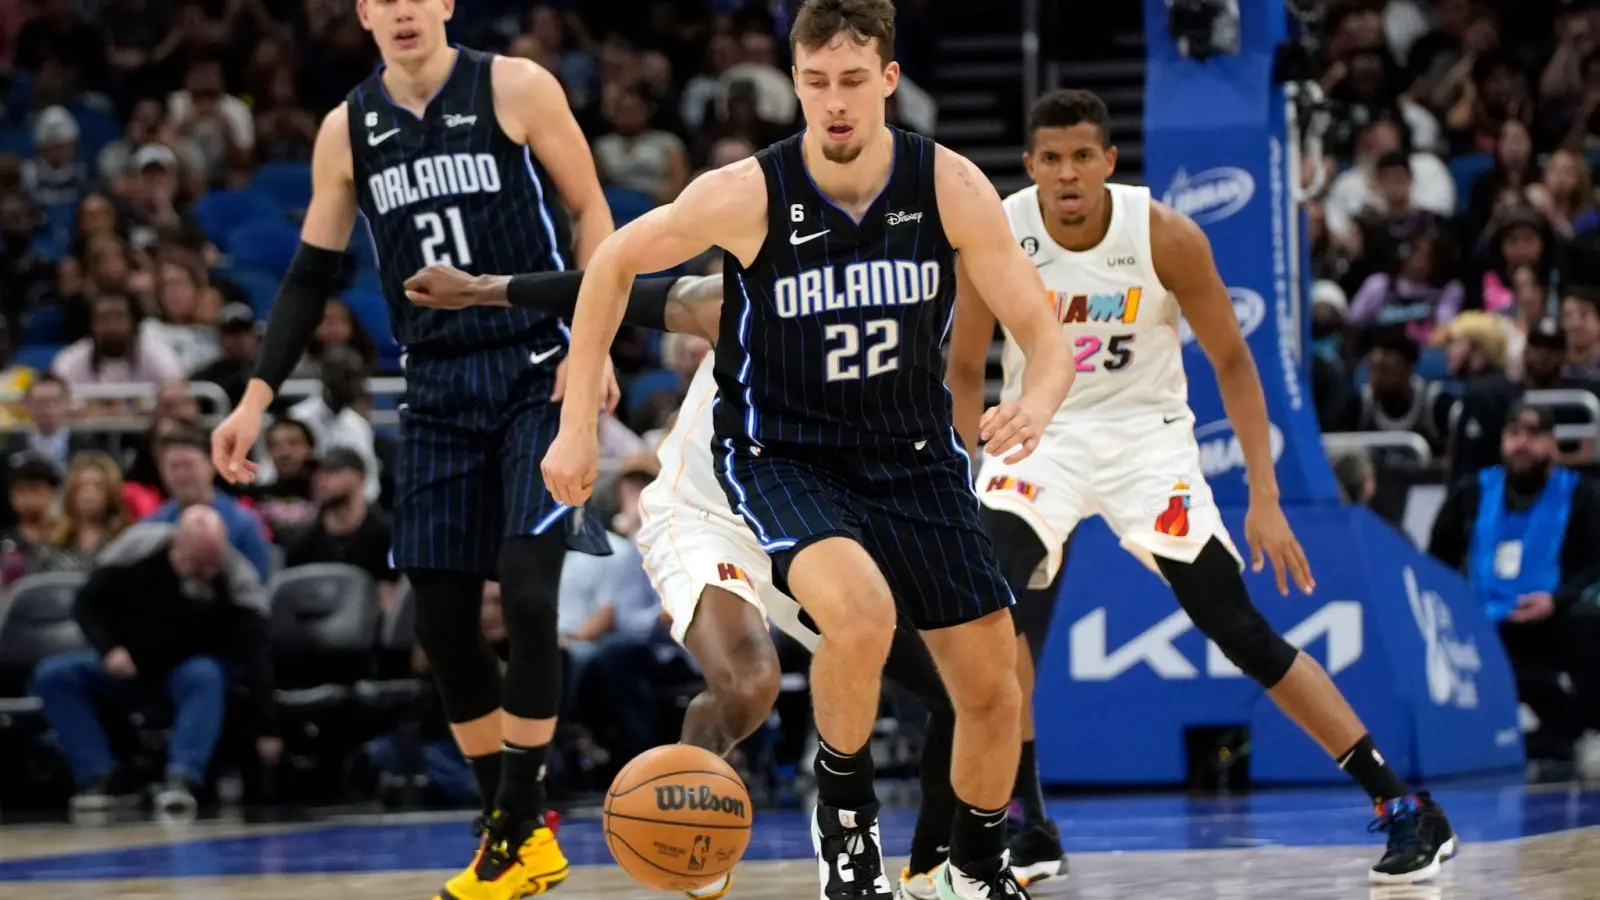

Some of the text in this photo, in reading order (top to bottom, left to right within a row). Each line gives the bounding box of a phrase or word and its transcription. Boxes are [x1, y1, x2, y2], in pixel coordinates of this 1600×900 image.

[365, 112, 379, 127] 6
[442, 114, 478, 128] Disney
[368, 153, 502, 216] ORLANDO
[790, 203, 805, 223] 6
[413, 206, 473, 267] 21
[1107, 256, 1137, 267] UKG
[775, 260, 940, 318] ORLANDO
[824, 318, 900, 382] 22
[1073, 334, 1136, 372] 25
[653, 784, 746, 819] Wilson
